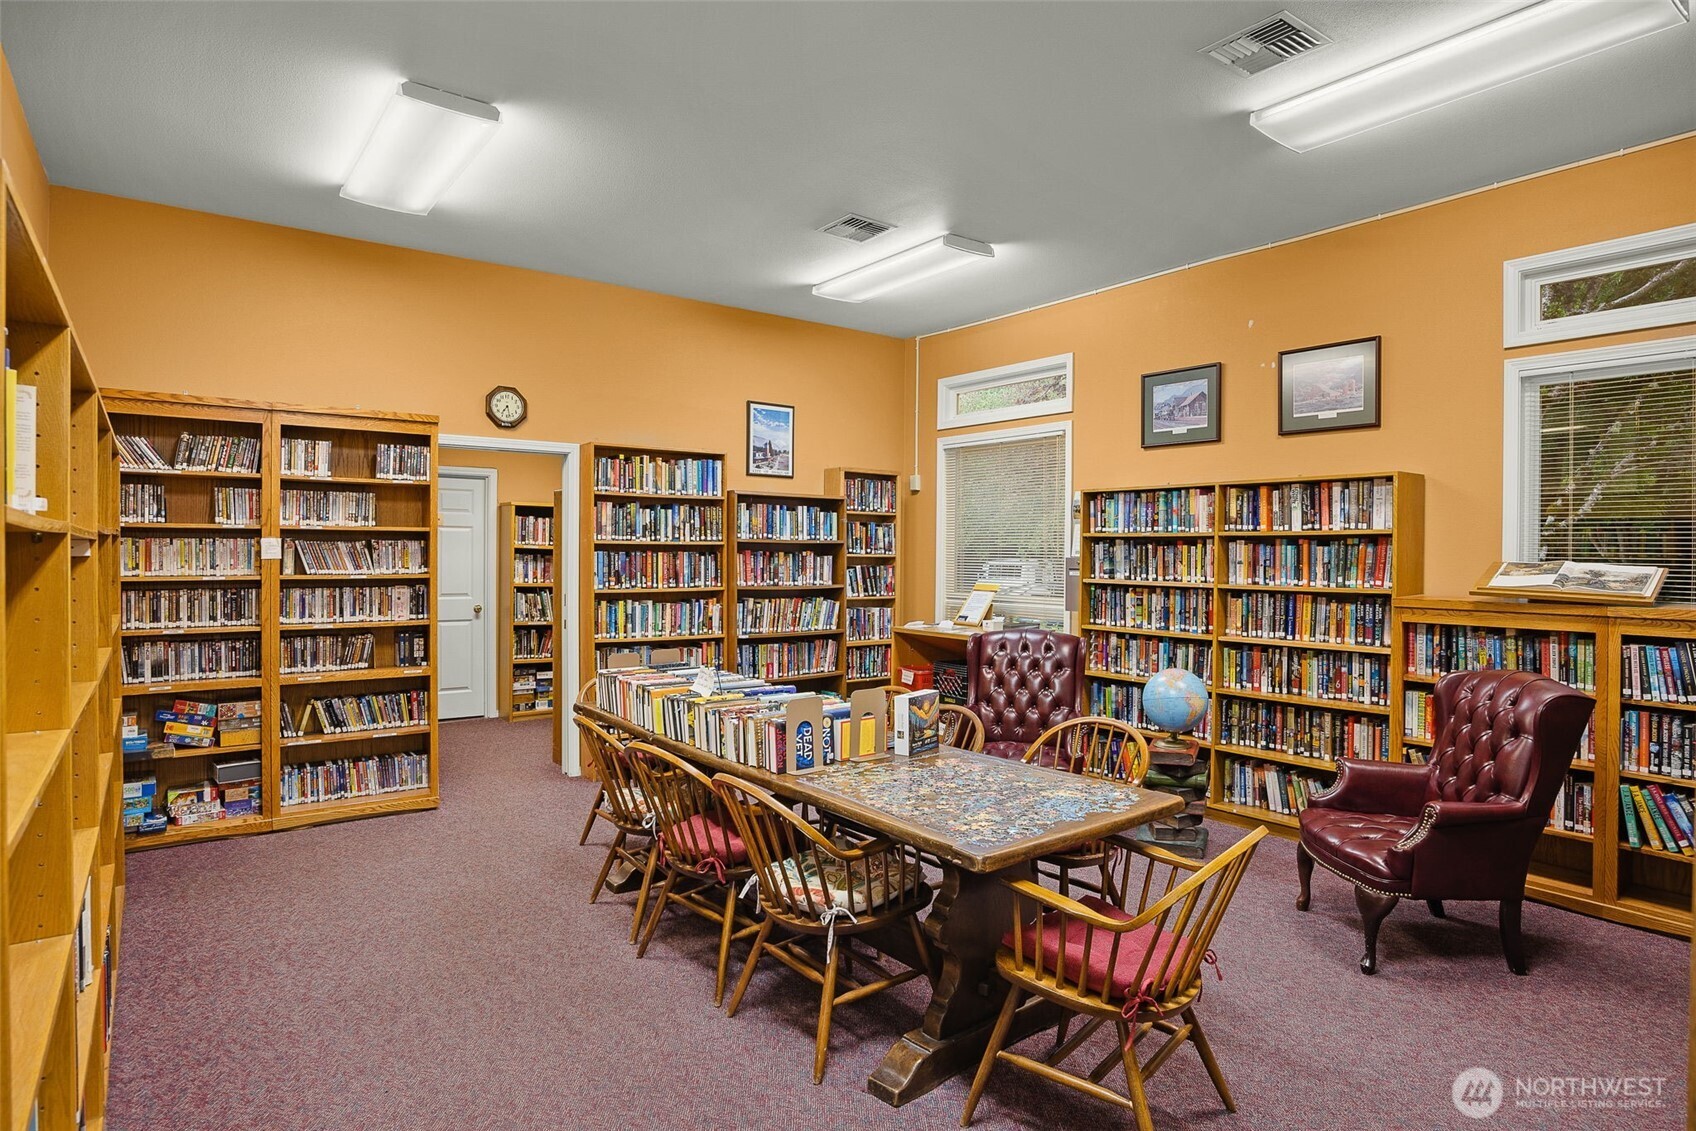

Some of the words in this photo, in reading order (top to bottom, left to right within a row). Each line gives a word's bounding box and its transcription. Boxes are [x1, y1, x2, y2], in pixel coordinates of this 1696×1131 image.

[776, 729, 784, 768] JACKSON
[803, 727, 813, 760] DEAD
[822, 728, 832, 752] NOT
